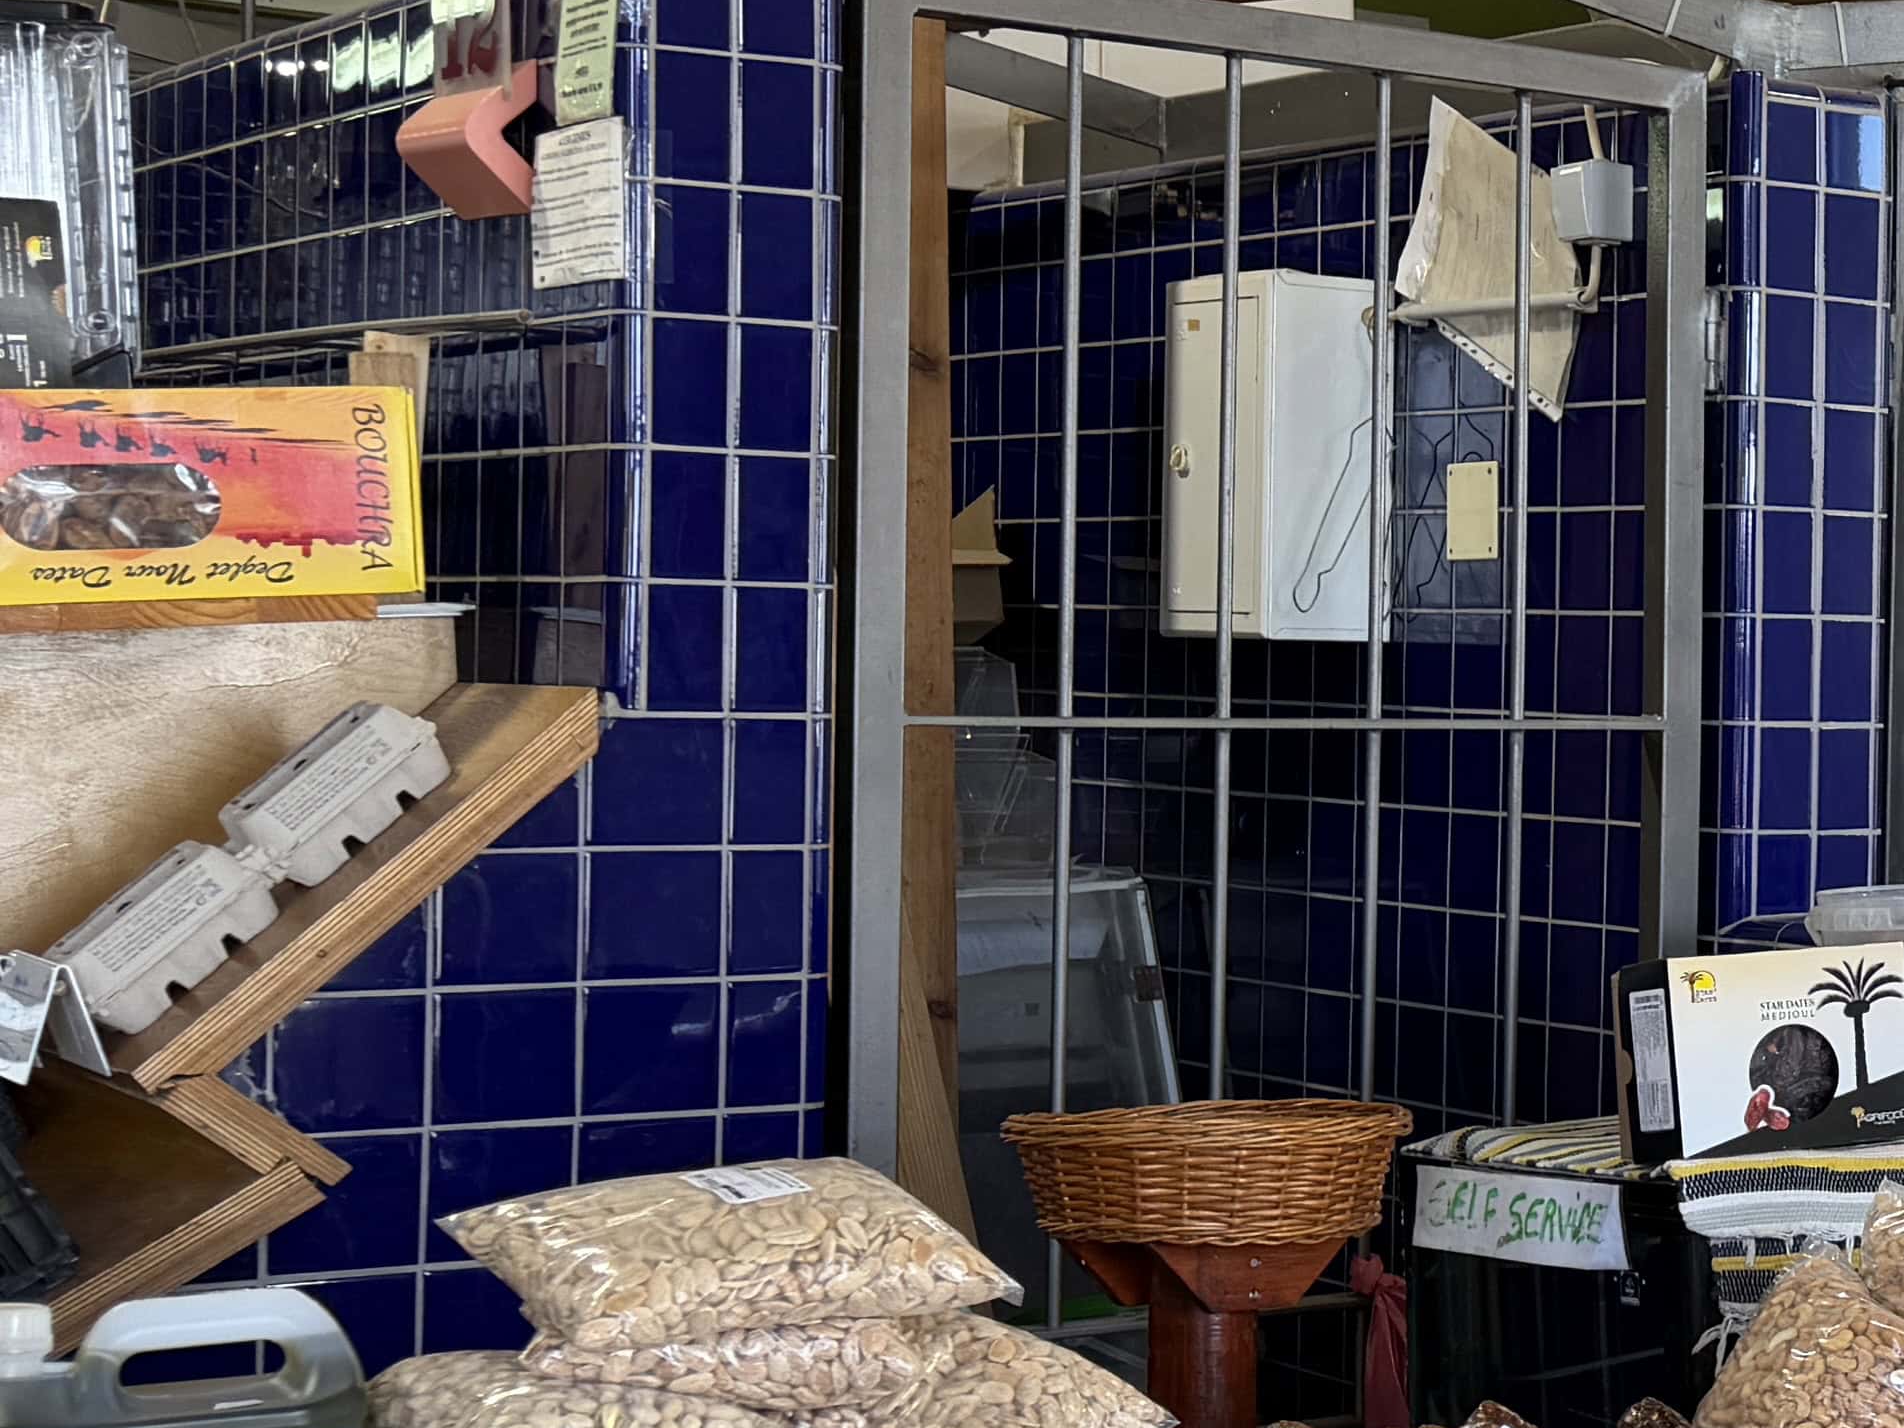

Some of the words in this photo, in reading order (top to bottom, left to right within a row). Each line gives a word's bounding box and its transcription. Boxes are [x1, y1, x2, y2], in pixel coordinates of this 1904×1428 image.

[352, 403, 395, 572] BOUCHRA
[31, 565, 114, 590] Dates
[124, 561, 196, 586] Nour
[207, 556, 296, 585] Deglet
[1760, 1000, 1784, 1011] STAR
[1785, 998, 1816, 1009] DATES
[1761, 1010, 1816, 1021] MEDJOUL
